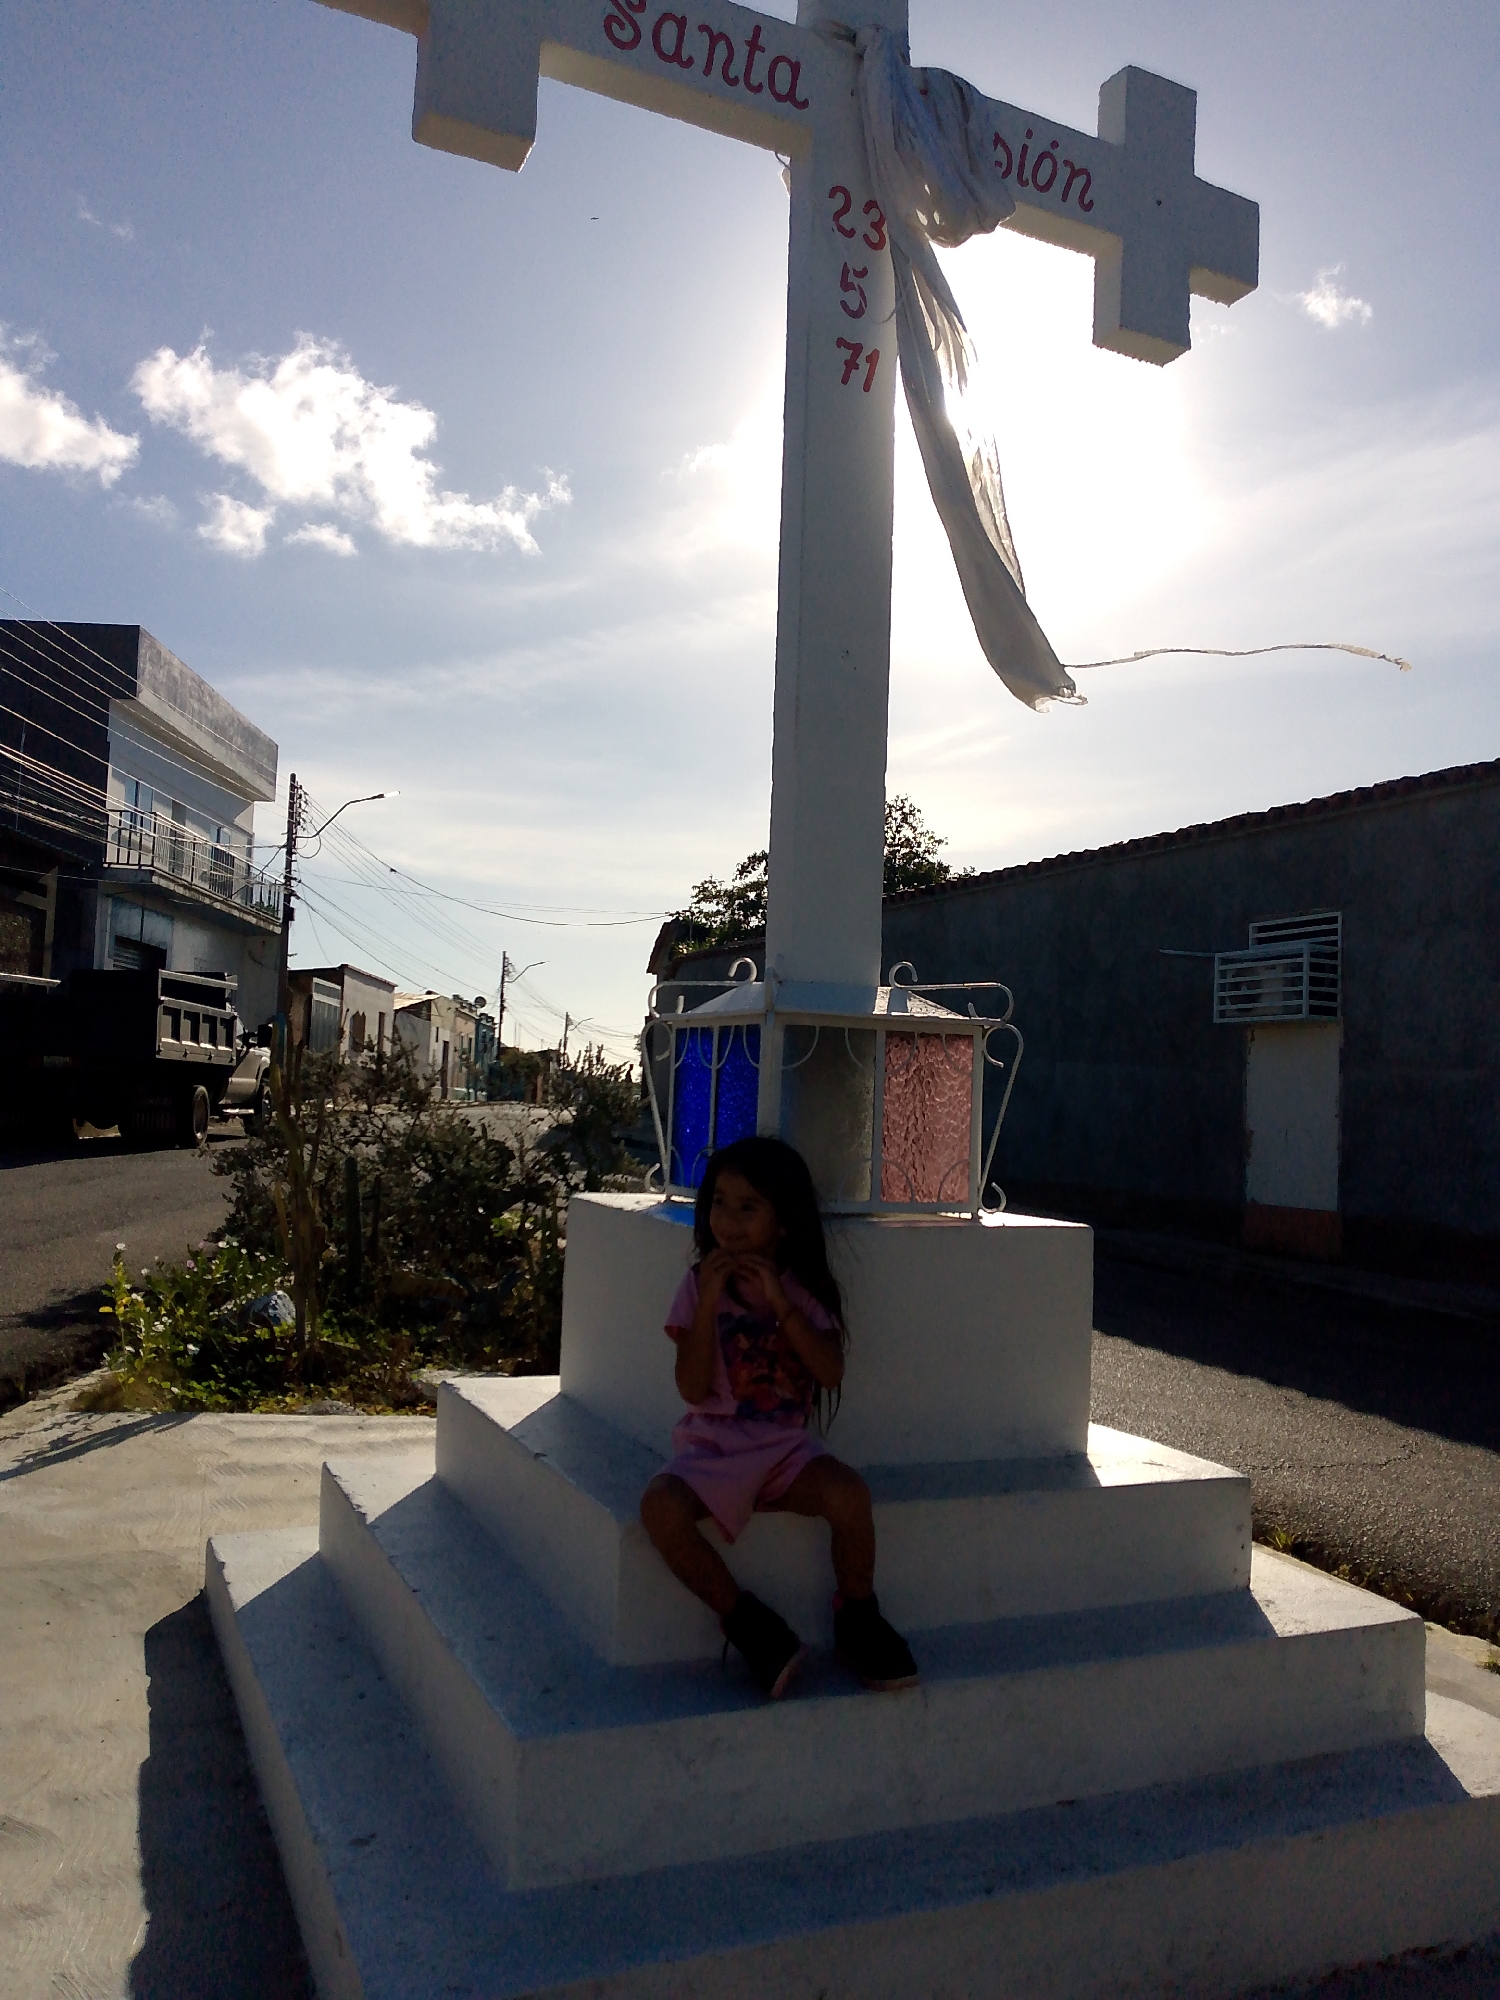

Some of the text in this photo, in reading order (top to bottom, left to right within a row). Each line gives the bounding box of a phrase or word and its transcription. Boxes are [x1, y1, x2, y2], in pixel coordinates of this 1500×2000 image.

[604, 0, 809, 110] Santa
[829, 186, 887, 251] 23
[840, 262, 869, 320] 5
[836, 337, 880, 392] 71
